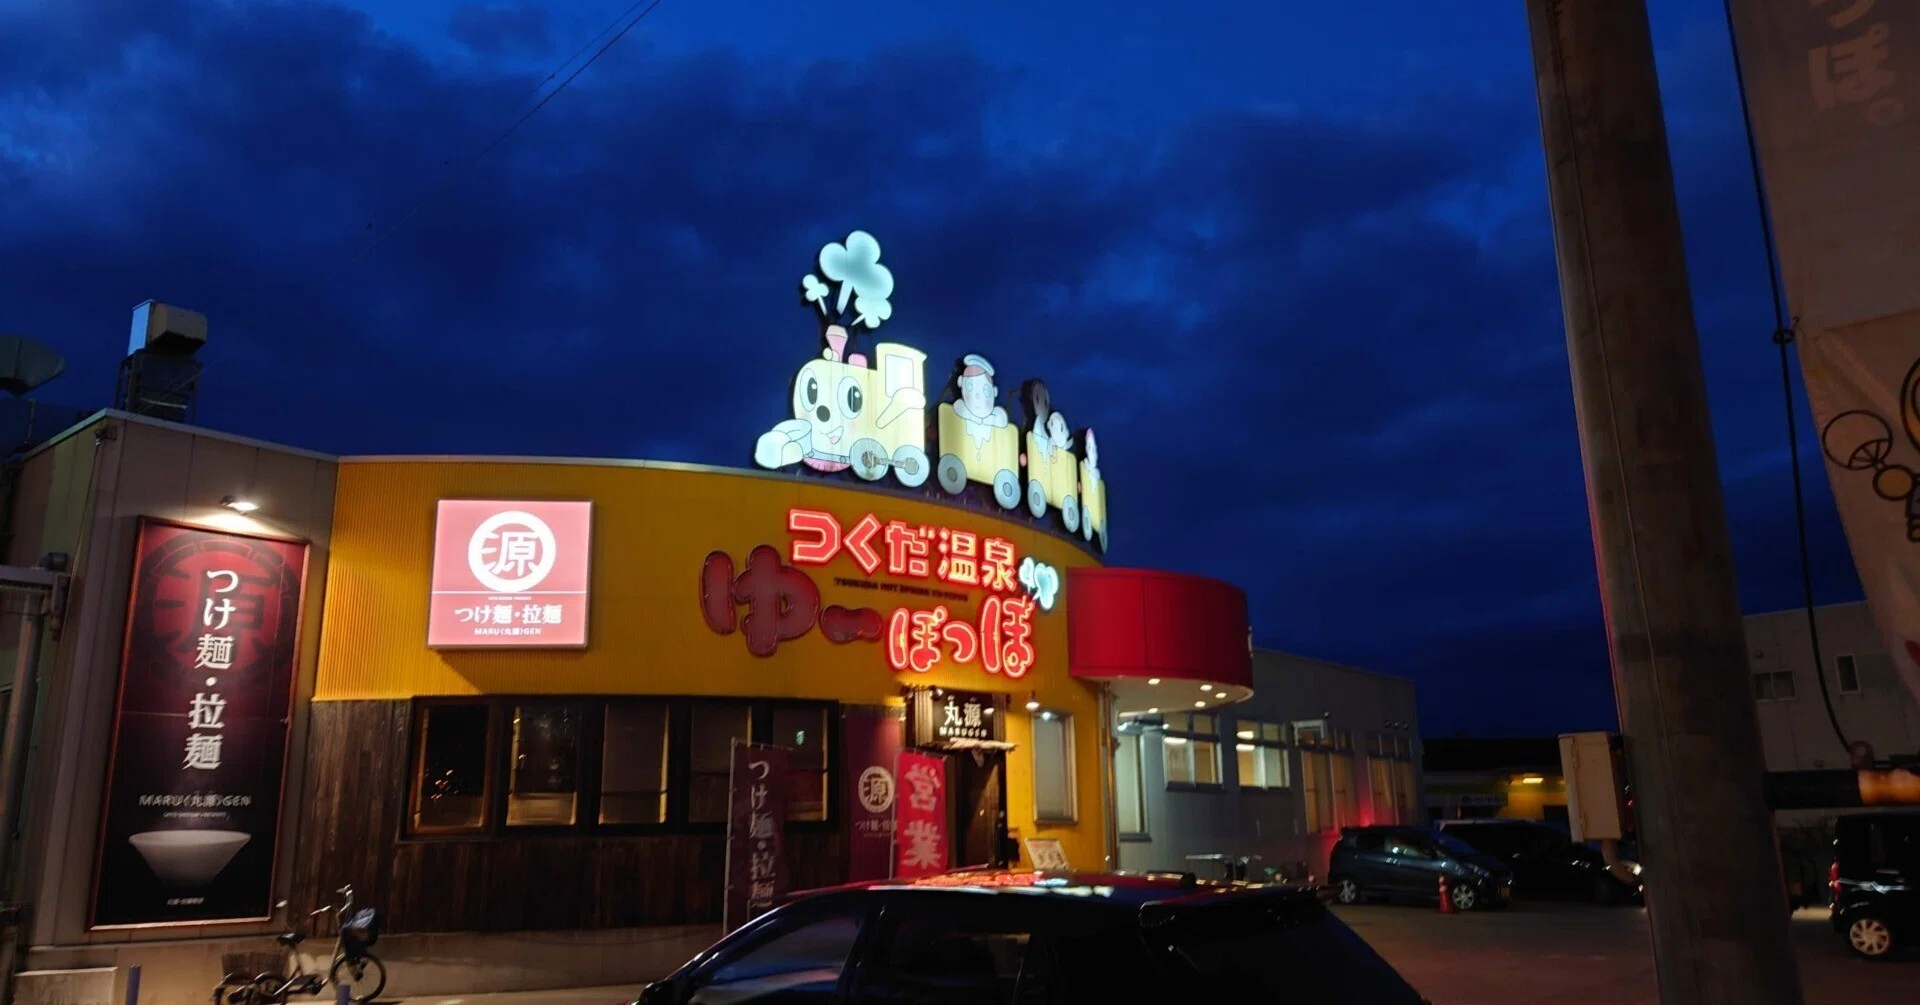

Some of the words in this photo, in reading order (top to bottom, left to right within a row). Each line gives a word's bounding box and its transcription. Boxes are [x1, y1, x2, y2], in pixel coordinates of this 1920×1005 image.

[790, 508, 1017, 591] つくだ温泉
[454, 603, 563, 624] つけ麺・拉麺
[182, 569, 240, 771] つけ麺・拉麺
[943, 700, 982, 728] 丸源
[938, 726, 988, 738] MARUGEN
